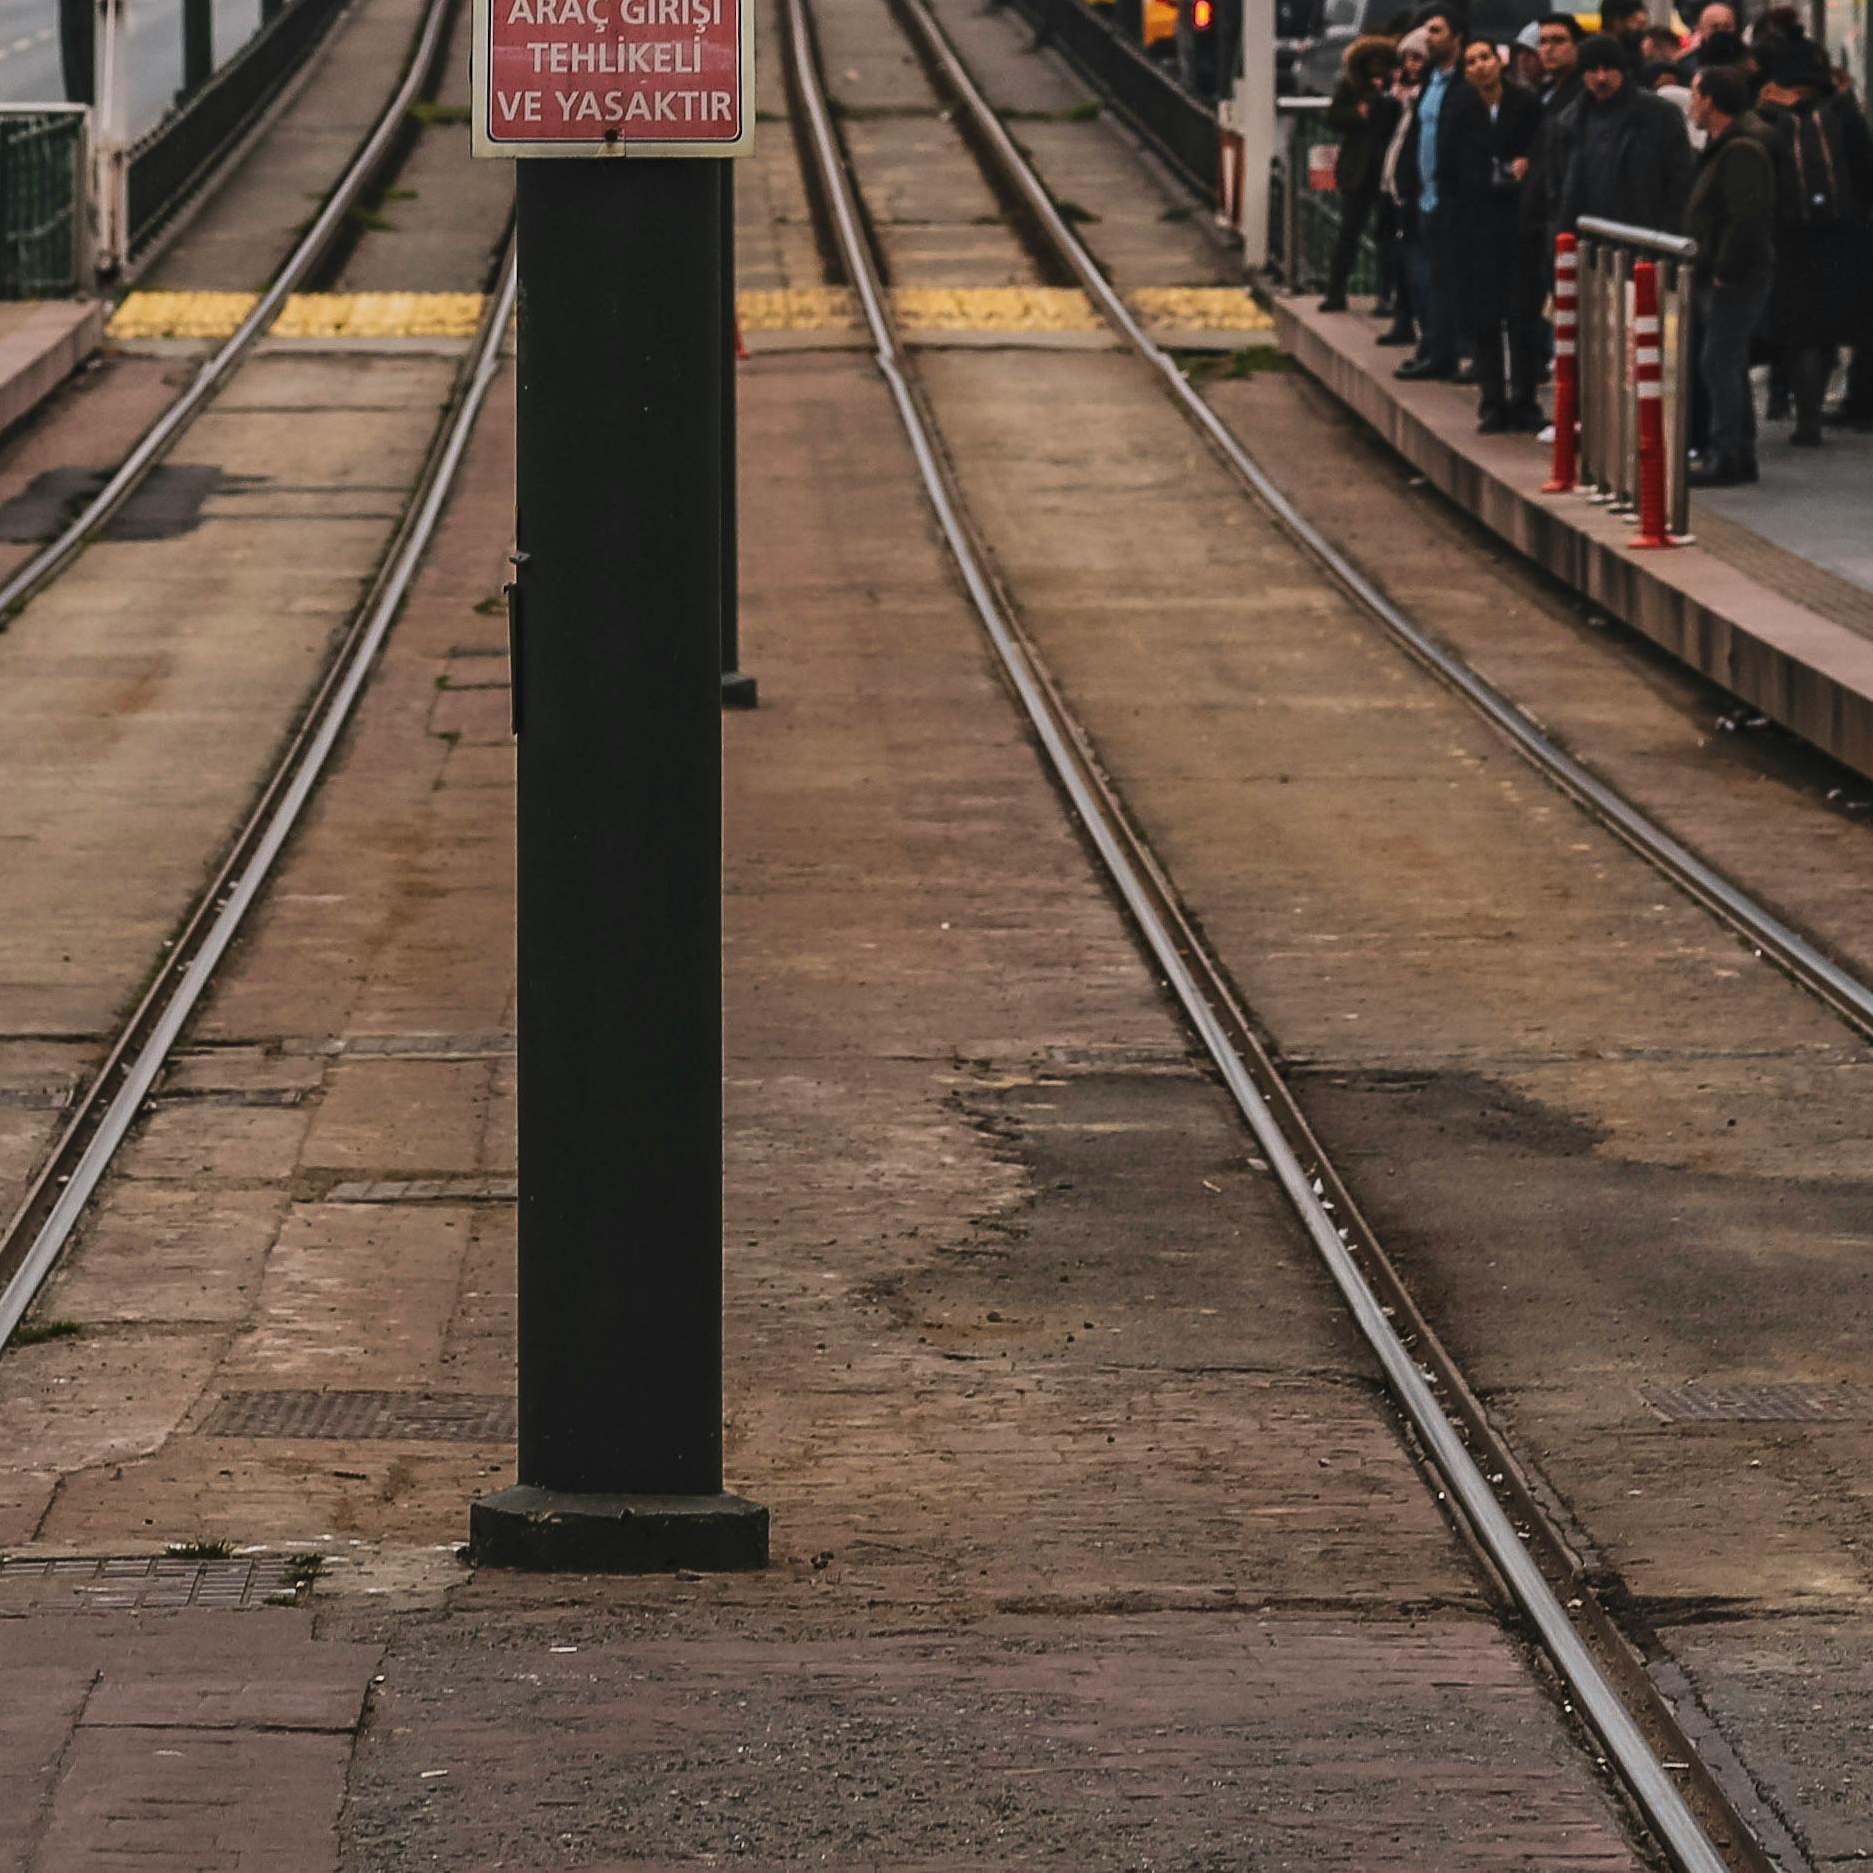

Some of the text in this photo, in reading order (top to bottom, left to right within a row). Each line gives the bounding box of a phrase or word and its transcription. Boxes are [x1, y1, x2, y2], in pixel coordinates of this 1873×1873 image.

[527, 35, 702, 73] TEHLİKELİ
[497, 90, 733, 122] VE YASAKTIR
